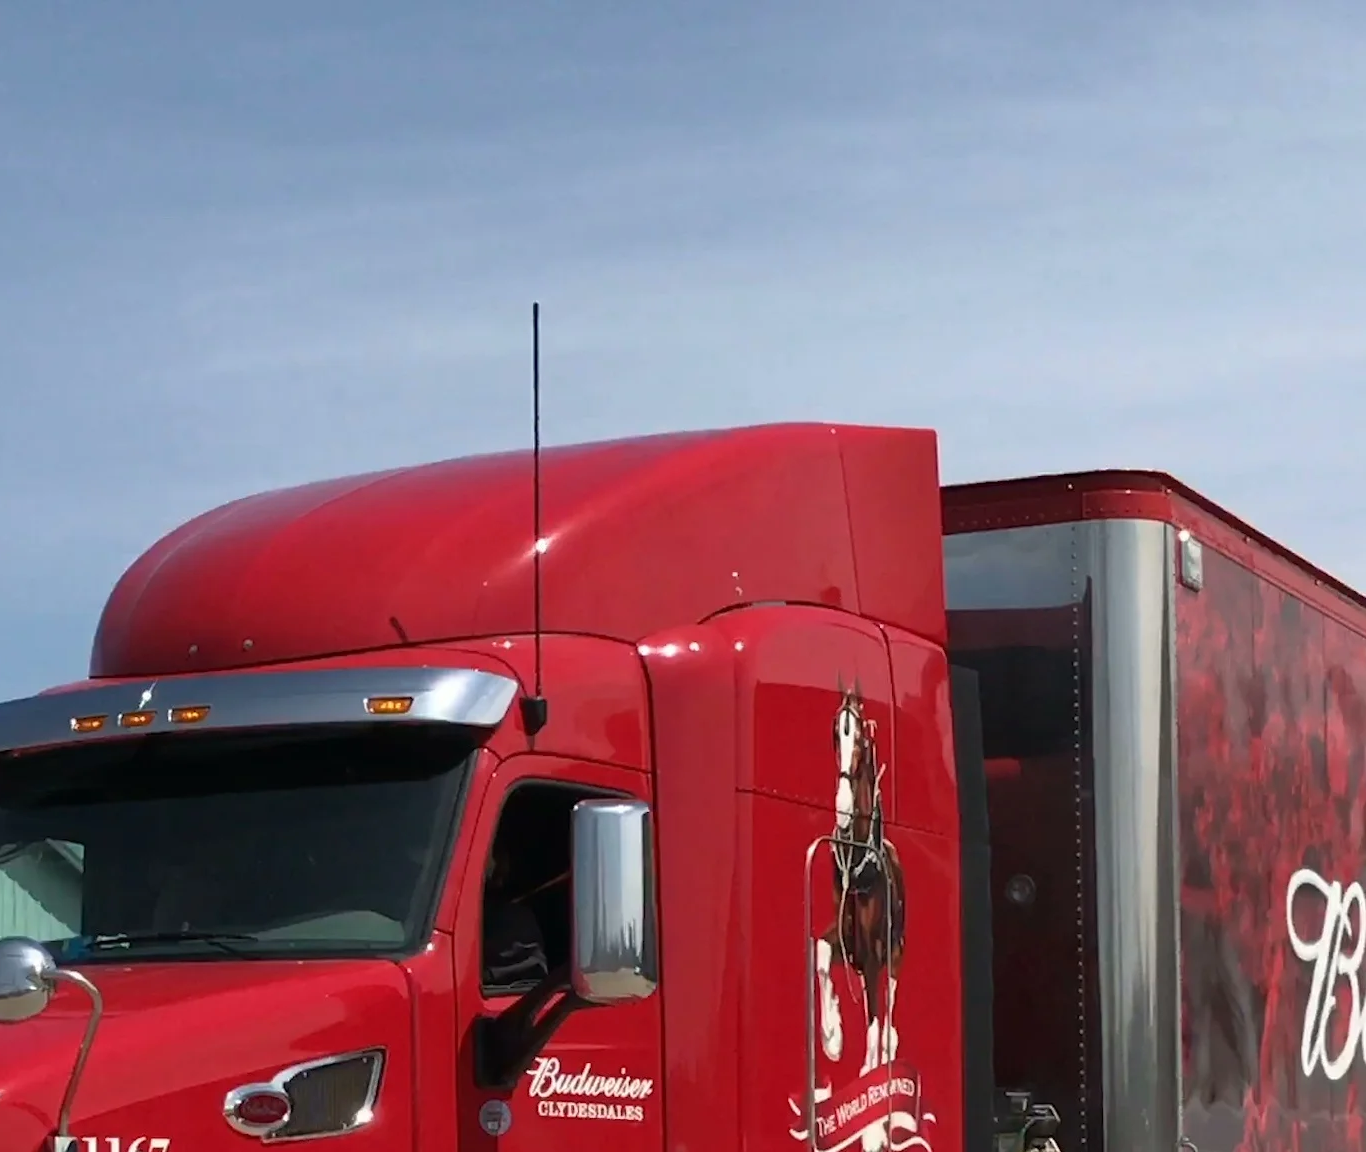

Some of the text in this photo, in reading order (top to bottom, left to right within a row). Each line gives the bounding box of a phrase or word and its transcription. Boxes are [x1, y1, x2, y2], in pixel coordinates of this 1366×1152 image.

[525, 1056, 654, 1099] Budweiser
[537, 1100, 645, 1121] CLYDESDALES
[816, 1116, 837, 1138] THE
[835, 1093, 868, 1128] WORLD
